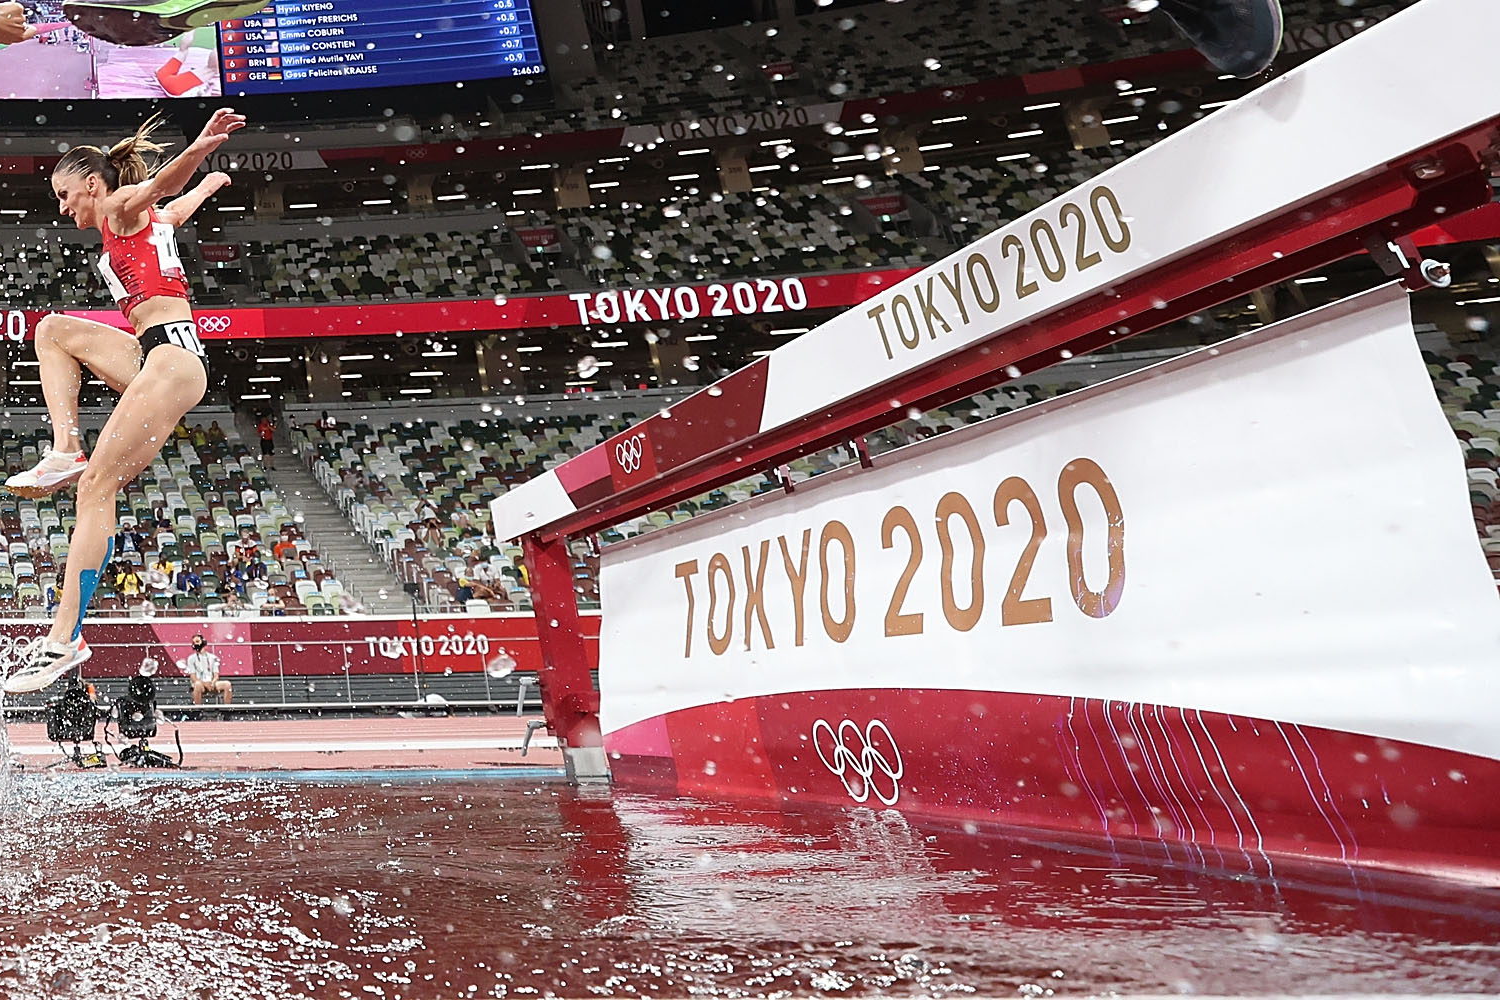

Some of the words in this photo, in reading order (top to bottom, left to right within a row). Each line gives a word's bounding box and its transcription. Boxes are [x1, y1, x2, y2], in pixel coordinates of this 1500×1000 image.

[225, 21, 232, 29] 4
[244, 19, 262, 28] USA
[280, 17, 316, 27] Courtney
[317, 13, 358, 24] FRERICHS
[278, 4, 301, 15] Hyvin
[301, 2, 334, 12] KIYENG
[227, 34, 233, 42] 4
[245, 32, 264, 41] USA
[281, 30, 306, 39] Emma
[307, 27, 345, 38] COBURN
[228, 46, 235, 55] 6
[246, 45, 265, 54] USA
[282, 43, 311, 52] Valerie
[311, 40, 356, 51] CONSTIEN
[499, 25, 517, 35] +0.7
[229, 60, 236, 68] 6
[248, 58, 266, 67] BRN
[283, 56, 317, 65] Winfred
[317, 54, 344, 64] Mutile
[344, 52, 364, 61] YAVI
[501, 38, 520, 48] +0.7
[230, 73, 237, 81] 8
[248, 72, 267, 80] GER
[285, 70, 307, 79] Gesa
[308, 67, 342, 78] Felicitas
[343, 65, 378, 75] KRAUSE
[504, 51, 523, 62] +0.9
[512, 65, 540, 76] 2:46.0
[653, 117, 740, 141] TOKYO
[745, 106, 809, 131] 2020
[236, 151, 293, 171] 2020
[867, 253, 1000, 360] TOKYO
[1001, 185, 1131, 300] 2020
[569, 286, 700, 325] TOKYO
[707, 277, 808, 317] 2020
[170, 325, 200, 352] 11
[675, 520, 856, 658] TOKYO
[881, 457, 1126, 638] 2020
[364, 635, 435, 658] TOKYO
[437, 633, 490, 656] 2020
